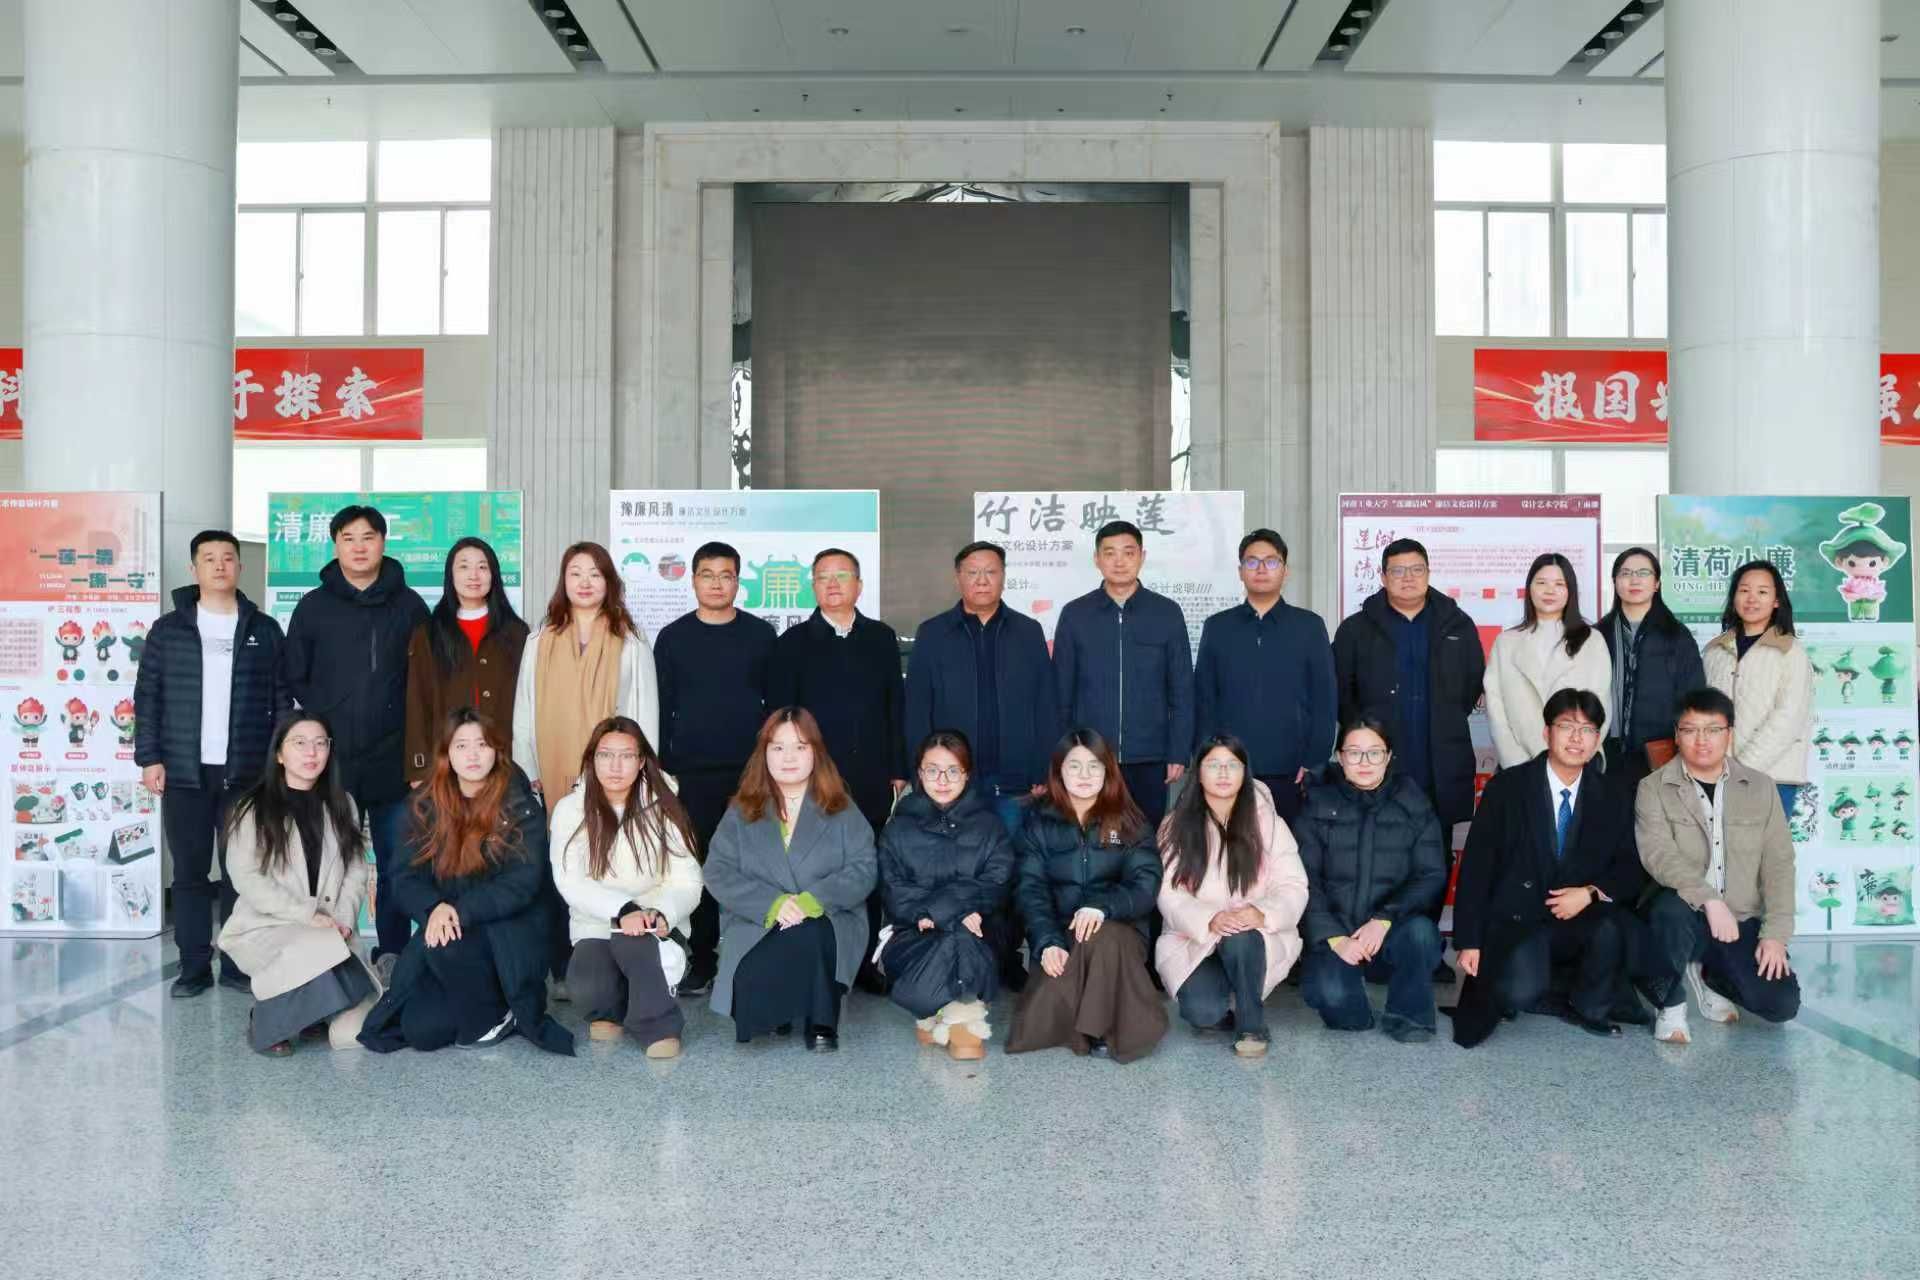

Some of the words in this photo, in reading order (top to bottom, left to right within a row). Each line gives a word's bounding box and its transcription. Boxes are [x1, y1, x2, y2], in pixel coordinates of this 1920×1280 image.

[275, 511, 404, 544] 清廉工
[977, 493, 1175, 536] 竹洁映莲
[1672, 545, 1796, 578] 清荷小廉
